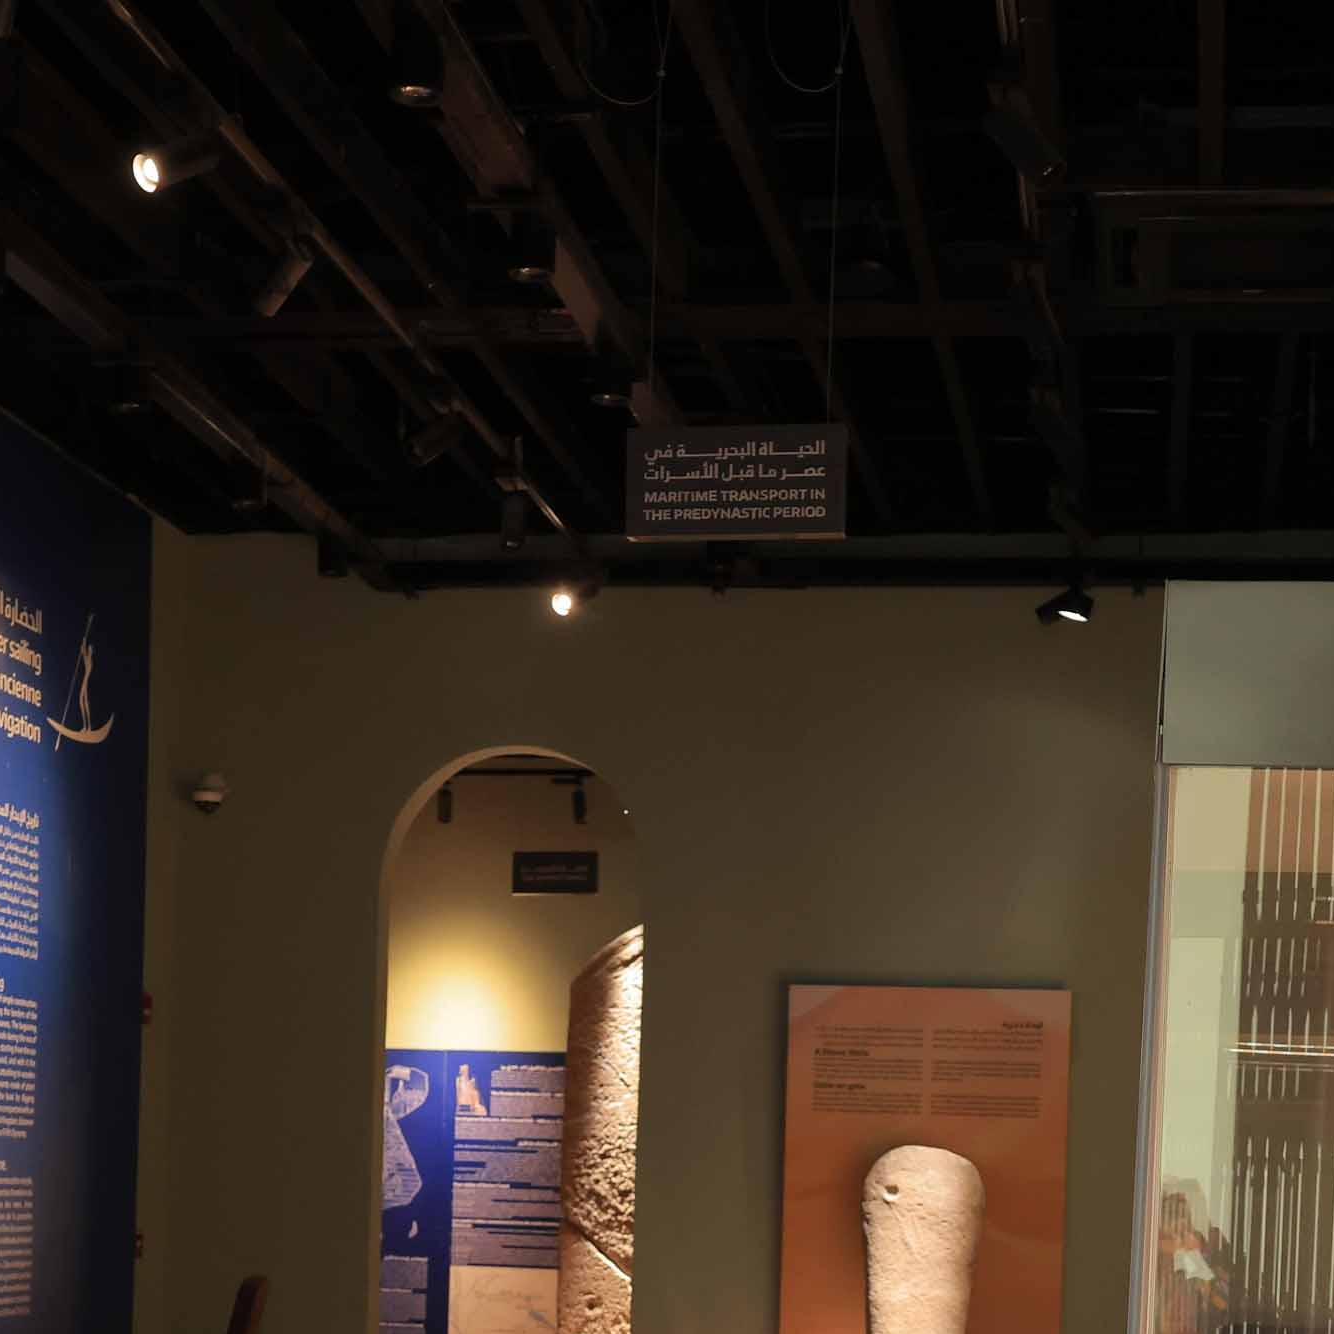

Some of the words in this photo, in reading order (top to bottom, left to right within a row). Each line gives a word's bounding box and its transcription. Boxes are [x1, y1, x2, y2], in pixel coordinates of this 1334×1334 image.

[644, 444, 673, 465] في
[643, 462, 719, 483] الأسرات
[721, 463, 755, 481] قبل
[758, 464, 777, 478] ما
[644, 490, 718, 503] MARITIME
[720, 488, 807, 501] TRANSPORT
[810, 488, 826, 500] IN
[643, 508, 672, 521] THE
[673, 507, 771, 520] PREDYNASTIC
[773, 505, 826, 518] PERIOD
[5, 596, 43, 634] الحضارة
[9, 639, 43, 677] sailing
